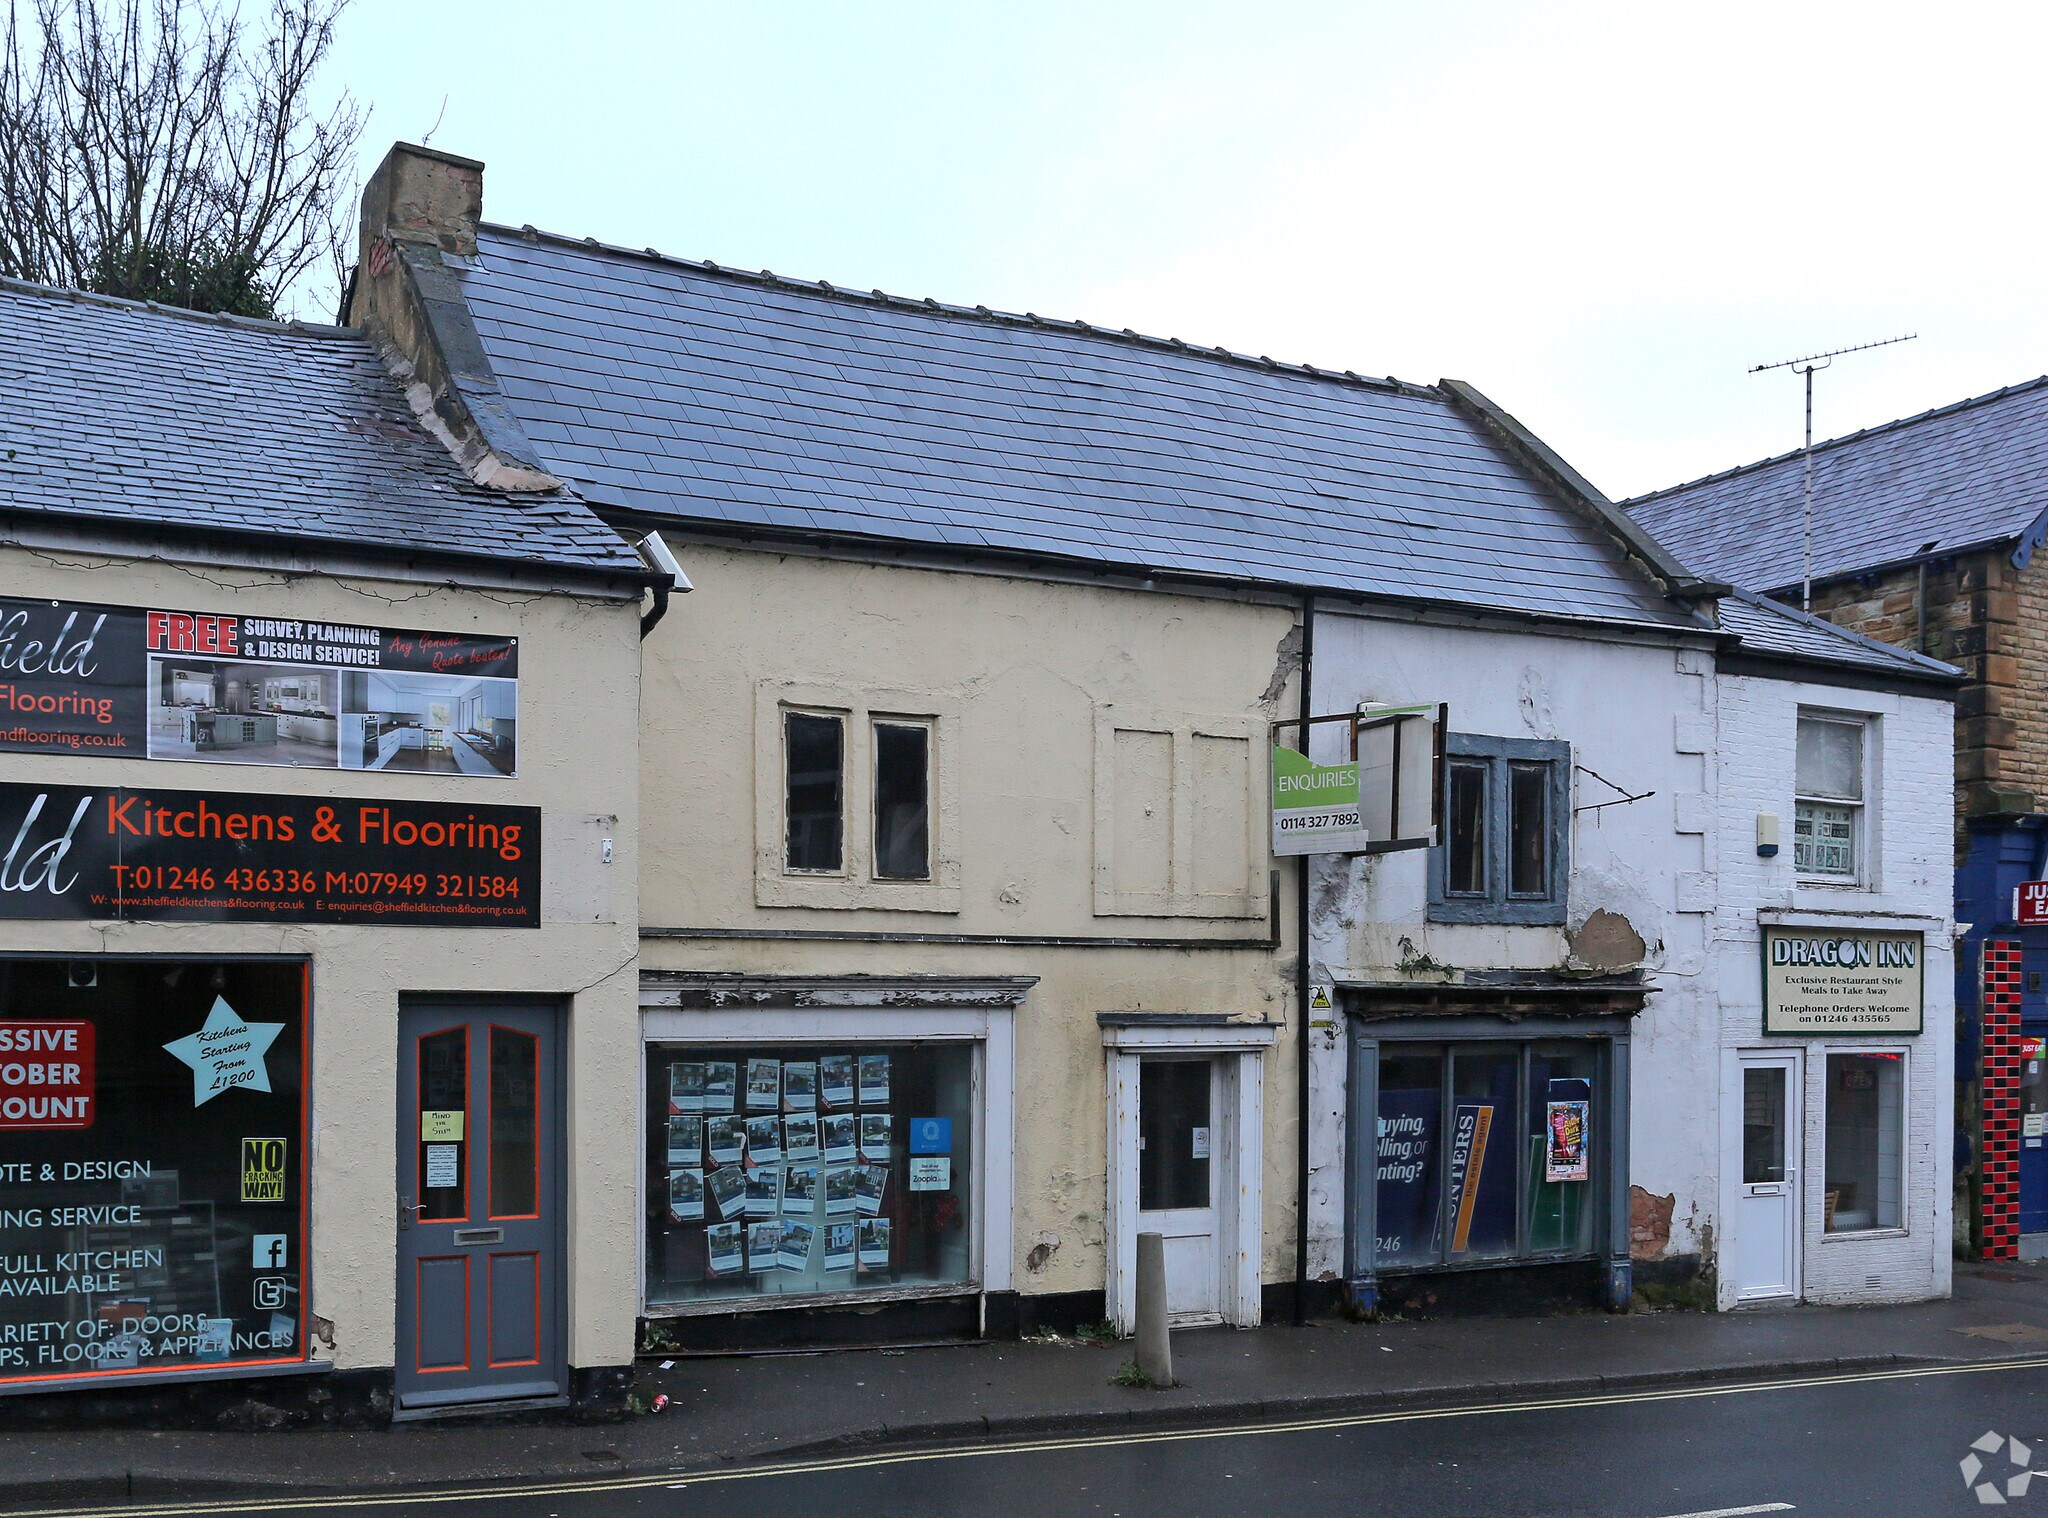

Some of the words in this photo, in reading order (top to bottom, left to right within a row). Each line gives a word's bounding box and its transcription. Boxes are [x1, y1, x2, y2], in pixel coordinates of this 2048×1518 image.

[147, 611, 238, 655] FREE
[244, 618, 304, 641] SURVEY,
[307, 624, 380, 646] PLANNING
[244, 642, 256, 657] &
[259, 641, 312, 661] DESIGN
[315, 645, 380, 666] SERVICE!
[389, 635, 413, 657] Any
[432, 651, 464, 671] Quote
[469, 643, 512, 664] beaten!
[1279, 770, 1356, 792] ENQUIRIES
[107, 796, 295, 842] Kitchens
[311, 806, 342, 843] &
[359, 807, 522, 861] Flooring
[1280, 817, 1306, 830] 0114
[1308, 815, 1329, 828] 327
[1331, 812, 1360, 826] 7892
[109, 865, 215, 891] T:01246
[224, 868, 316, 894] 436336
[325, 871, 427, 896] M:07949
[436, 874, 520, 899] 321584
[2025, 885, 2048, 900] JU
[1773, 937, 1871, 970] DRAGON
[1877, 940, 1915, 968] INN
[1785, 975, 1828, 985] Exclusive
[1830, 976, 1879, 985] Restaurant
[1881, 977, 1903, 987] Style
[1801, 986, 1827, 994] Meals
[1865, 987, 1888, 996] Away
[1778, 1004, 1829, 1014] Telephone
[1832, 1005, 1865, 1013] Orders
[1867, 1005, 1910, 1013] Welcome
[1814, 1014, 1848, 1022] 01246
[195, 1024, 249, 1044] Kitchens
[200, 1041, 252, 1060] Starting
[2022, 1044, 2034, 1052] JUST
[0, 1062, 81, 1086] OBER
[212, 1059, 247, 1075] From
[208, 1069, 256, 1091] £1200
[0, 1096, 90, 1120] OUNT
[244, 1141, 283, 1172] NO
[39, 1163, 56, 1181] &
[63, 1160, 151, 1181] DESIGN
[244, 1171, 283, 1183] FRACKING
[244, 1182, 282, 1199] WAY!
[50, 1205, 141, 1227] SERVICE
[56, 1249, 162, 1272] KITCHEN
[0, 1273, 120, 1297] AVAILABLE
[0, 1321, 71, 1343] RIETY
[76, 1318, 114, 1339] OF:
[38, 1340, 133, 1364] FLOORS
[140, 1343, 155, 1357] &
